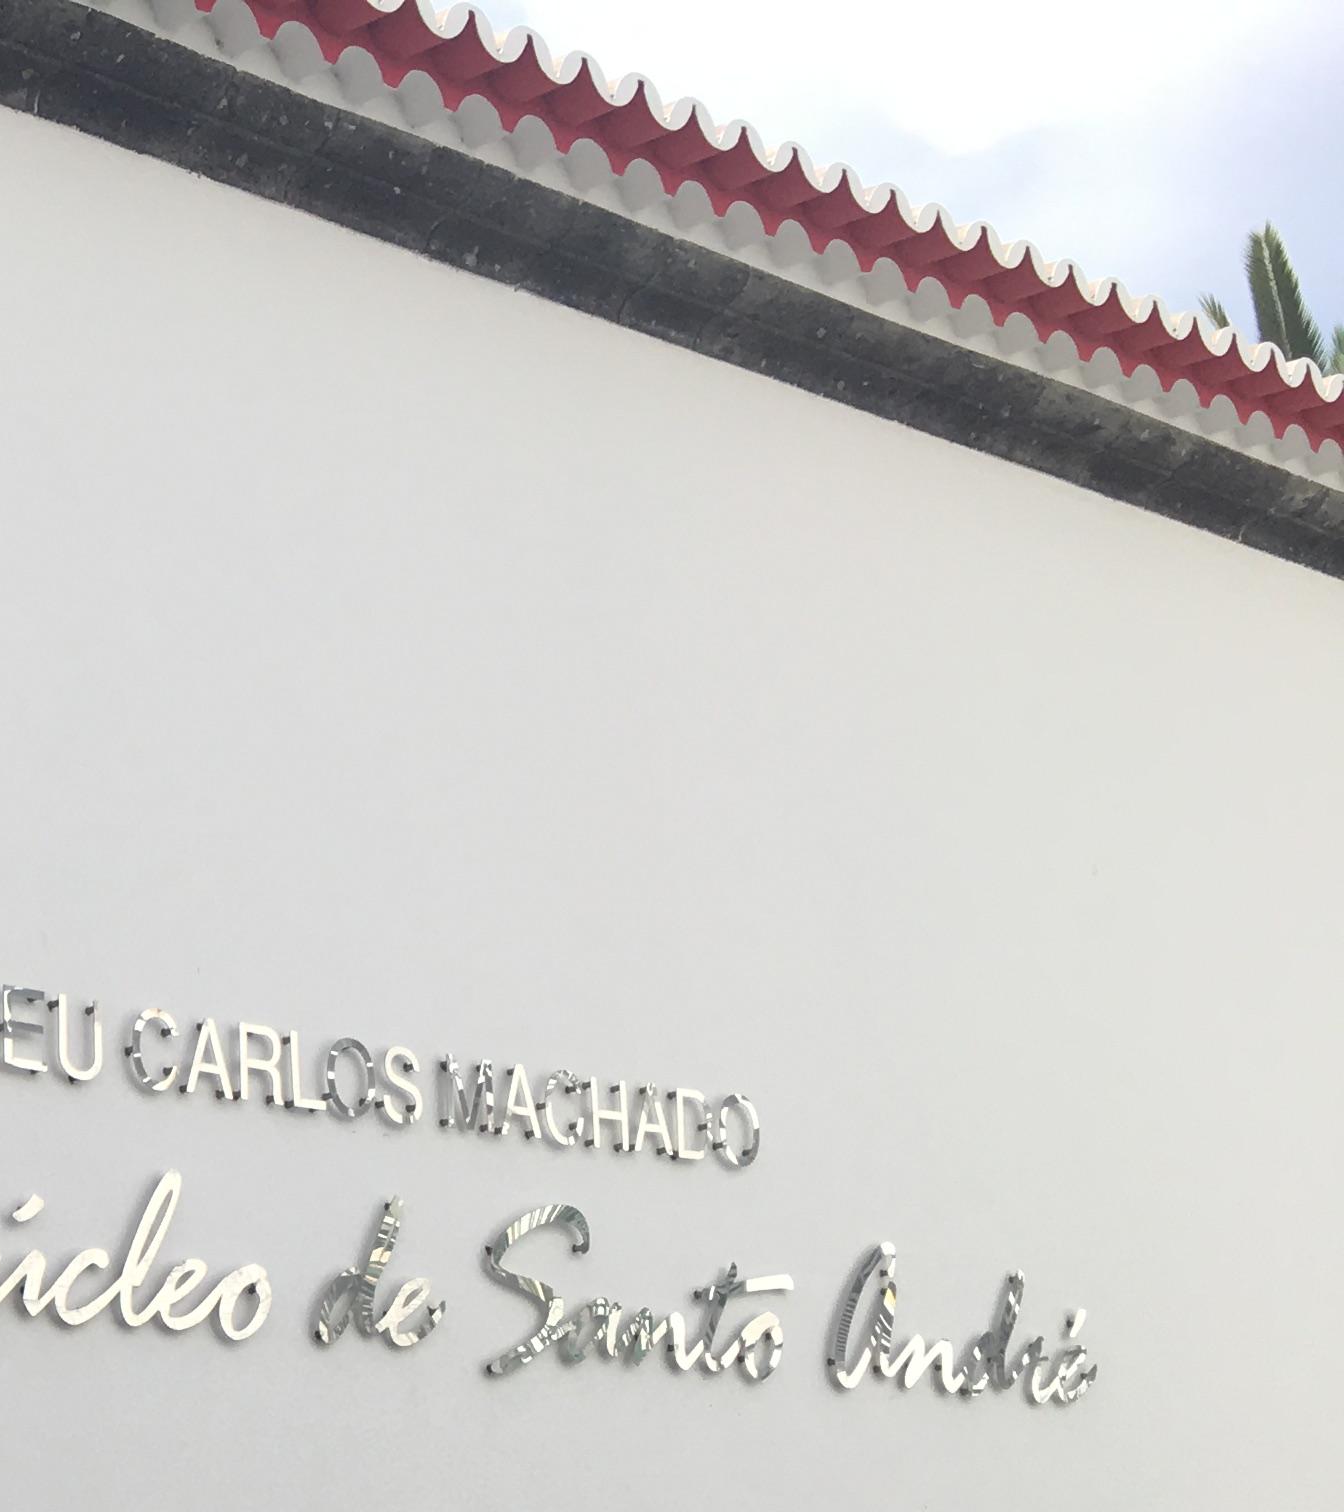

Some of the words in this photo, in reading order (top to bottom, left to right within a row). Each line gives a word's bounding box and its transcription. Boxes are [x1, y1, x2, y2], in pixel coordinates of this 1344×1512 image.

[131, 1007, 424, 1125] CARLOS
[442, 1053, 760, 1168] MACHADO
[315, 1195, 447, 1347] de
[485, 1203, 795, 1383] Santo
[832, 1240, 1098, 1404] André
